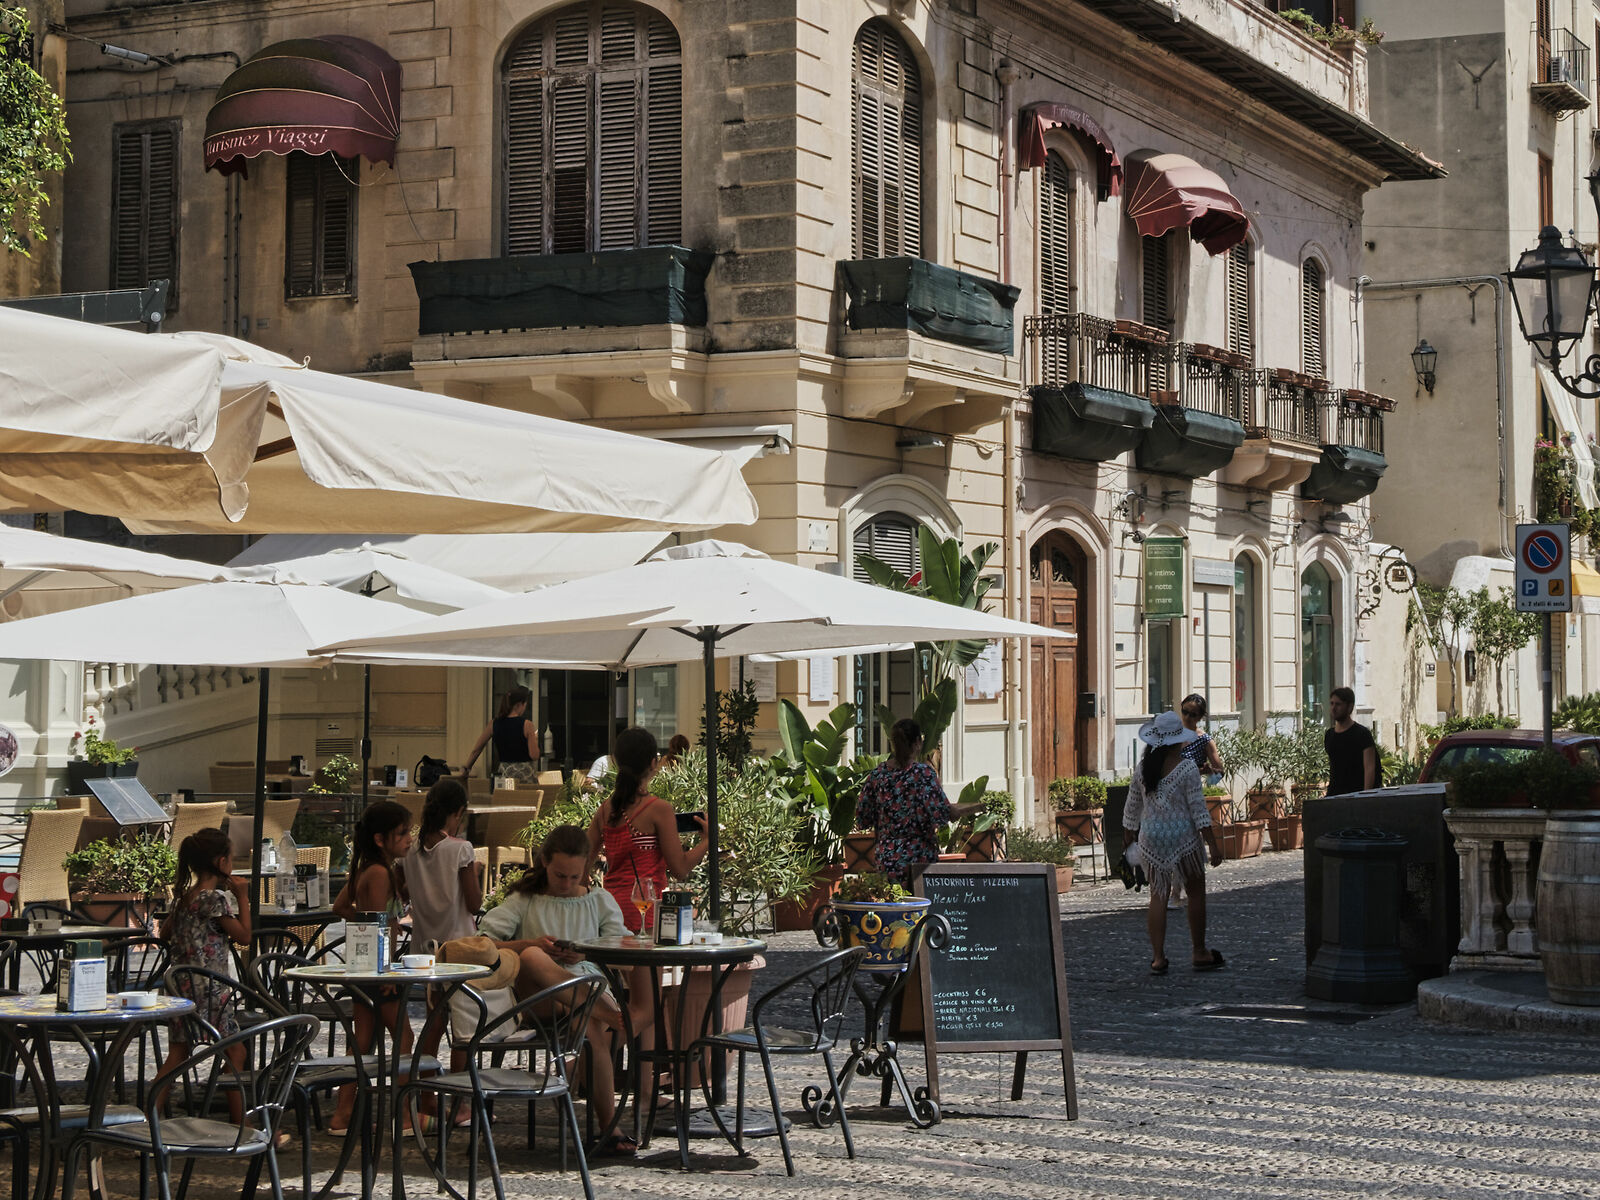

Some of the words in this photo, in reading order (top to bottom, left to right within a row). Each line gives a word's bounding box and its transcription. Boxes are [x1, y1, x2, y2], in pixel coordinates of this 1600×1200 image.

[267, 128, 328, 147] Viaggi
[1525, 581, 1535, 595] P
[925, 877, 975, 887] RISTORANTE
[982, 877, 1019, 887] PIZZERIA
[666, 893, 677, 904] 30
